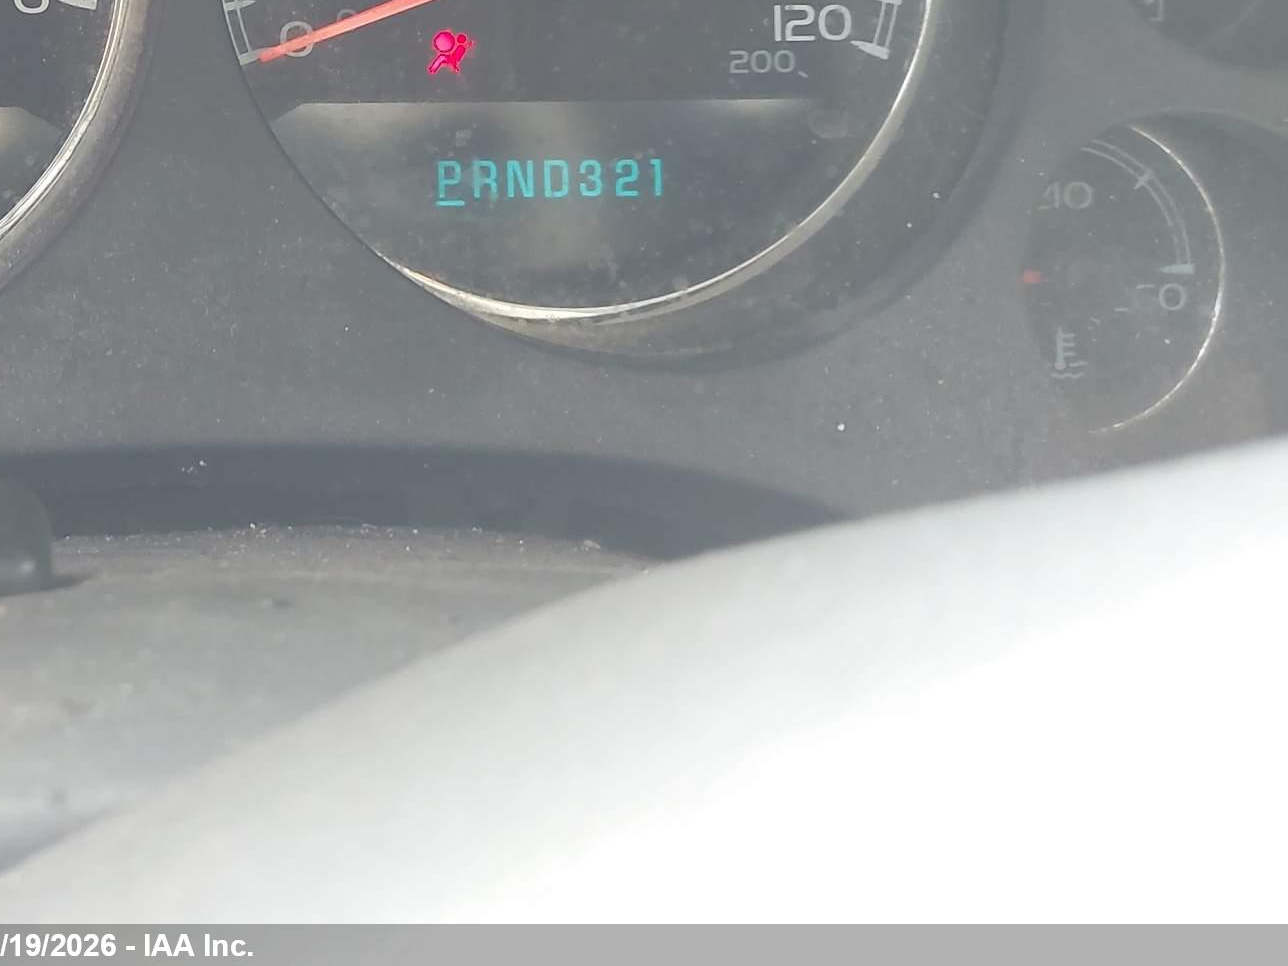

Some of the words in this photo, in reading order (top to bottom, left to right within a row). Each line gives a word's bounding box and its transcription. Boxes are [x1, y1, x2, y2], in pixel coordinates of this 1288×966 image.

[279, 20, 314, 57] 0
[774, 5, 852, 41] 120
[729, 52, 795, 74] 200
[437, 158, 662, 198] PRND321
